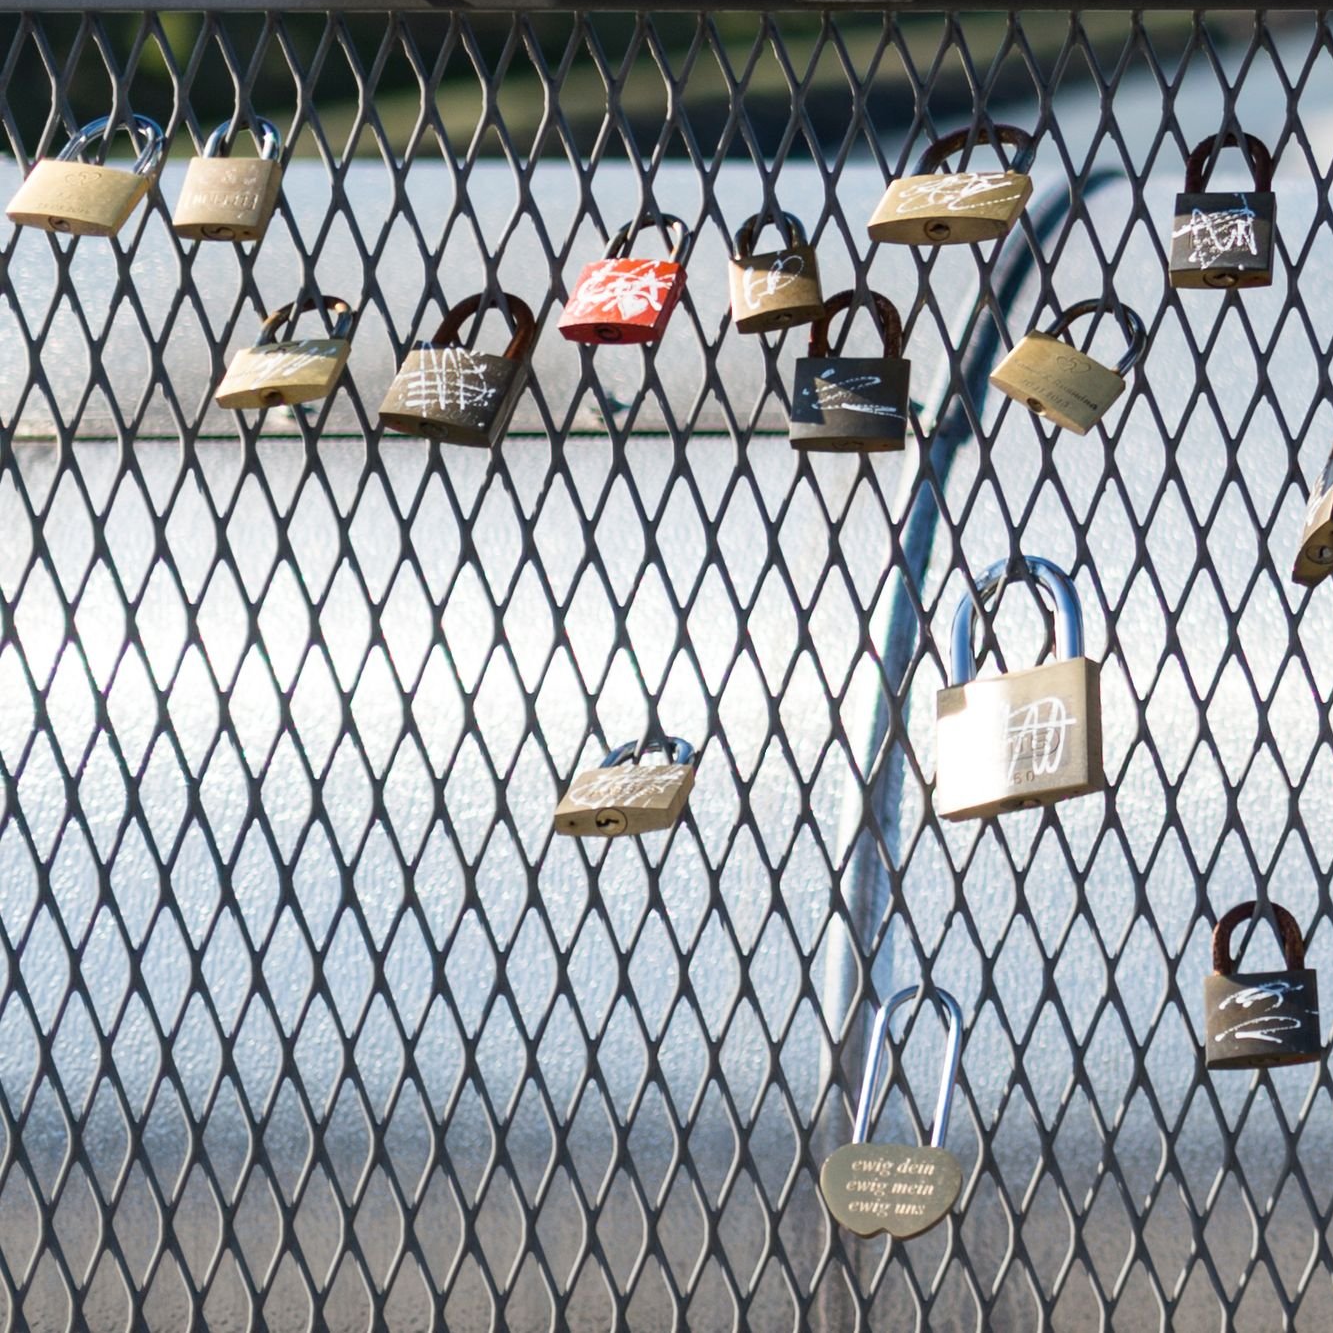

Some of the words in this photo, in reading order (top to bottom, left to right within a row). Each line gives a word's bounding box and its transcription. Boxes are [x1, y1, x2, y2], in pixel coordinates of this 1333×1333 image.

[851, 1157, 894, 1176] ewig
[896, 1157, 935, 1176] dein
[846, 1177, 888, 1196] ewig
[891, 1179, 934, 1196] mein
[848, 1198, 891, 1217] ewig
[894, 1203, 926, 1215] uns
